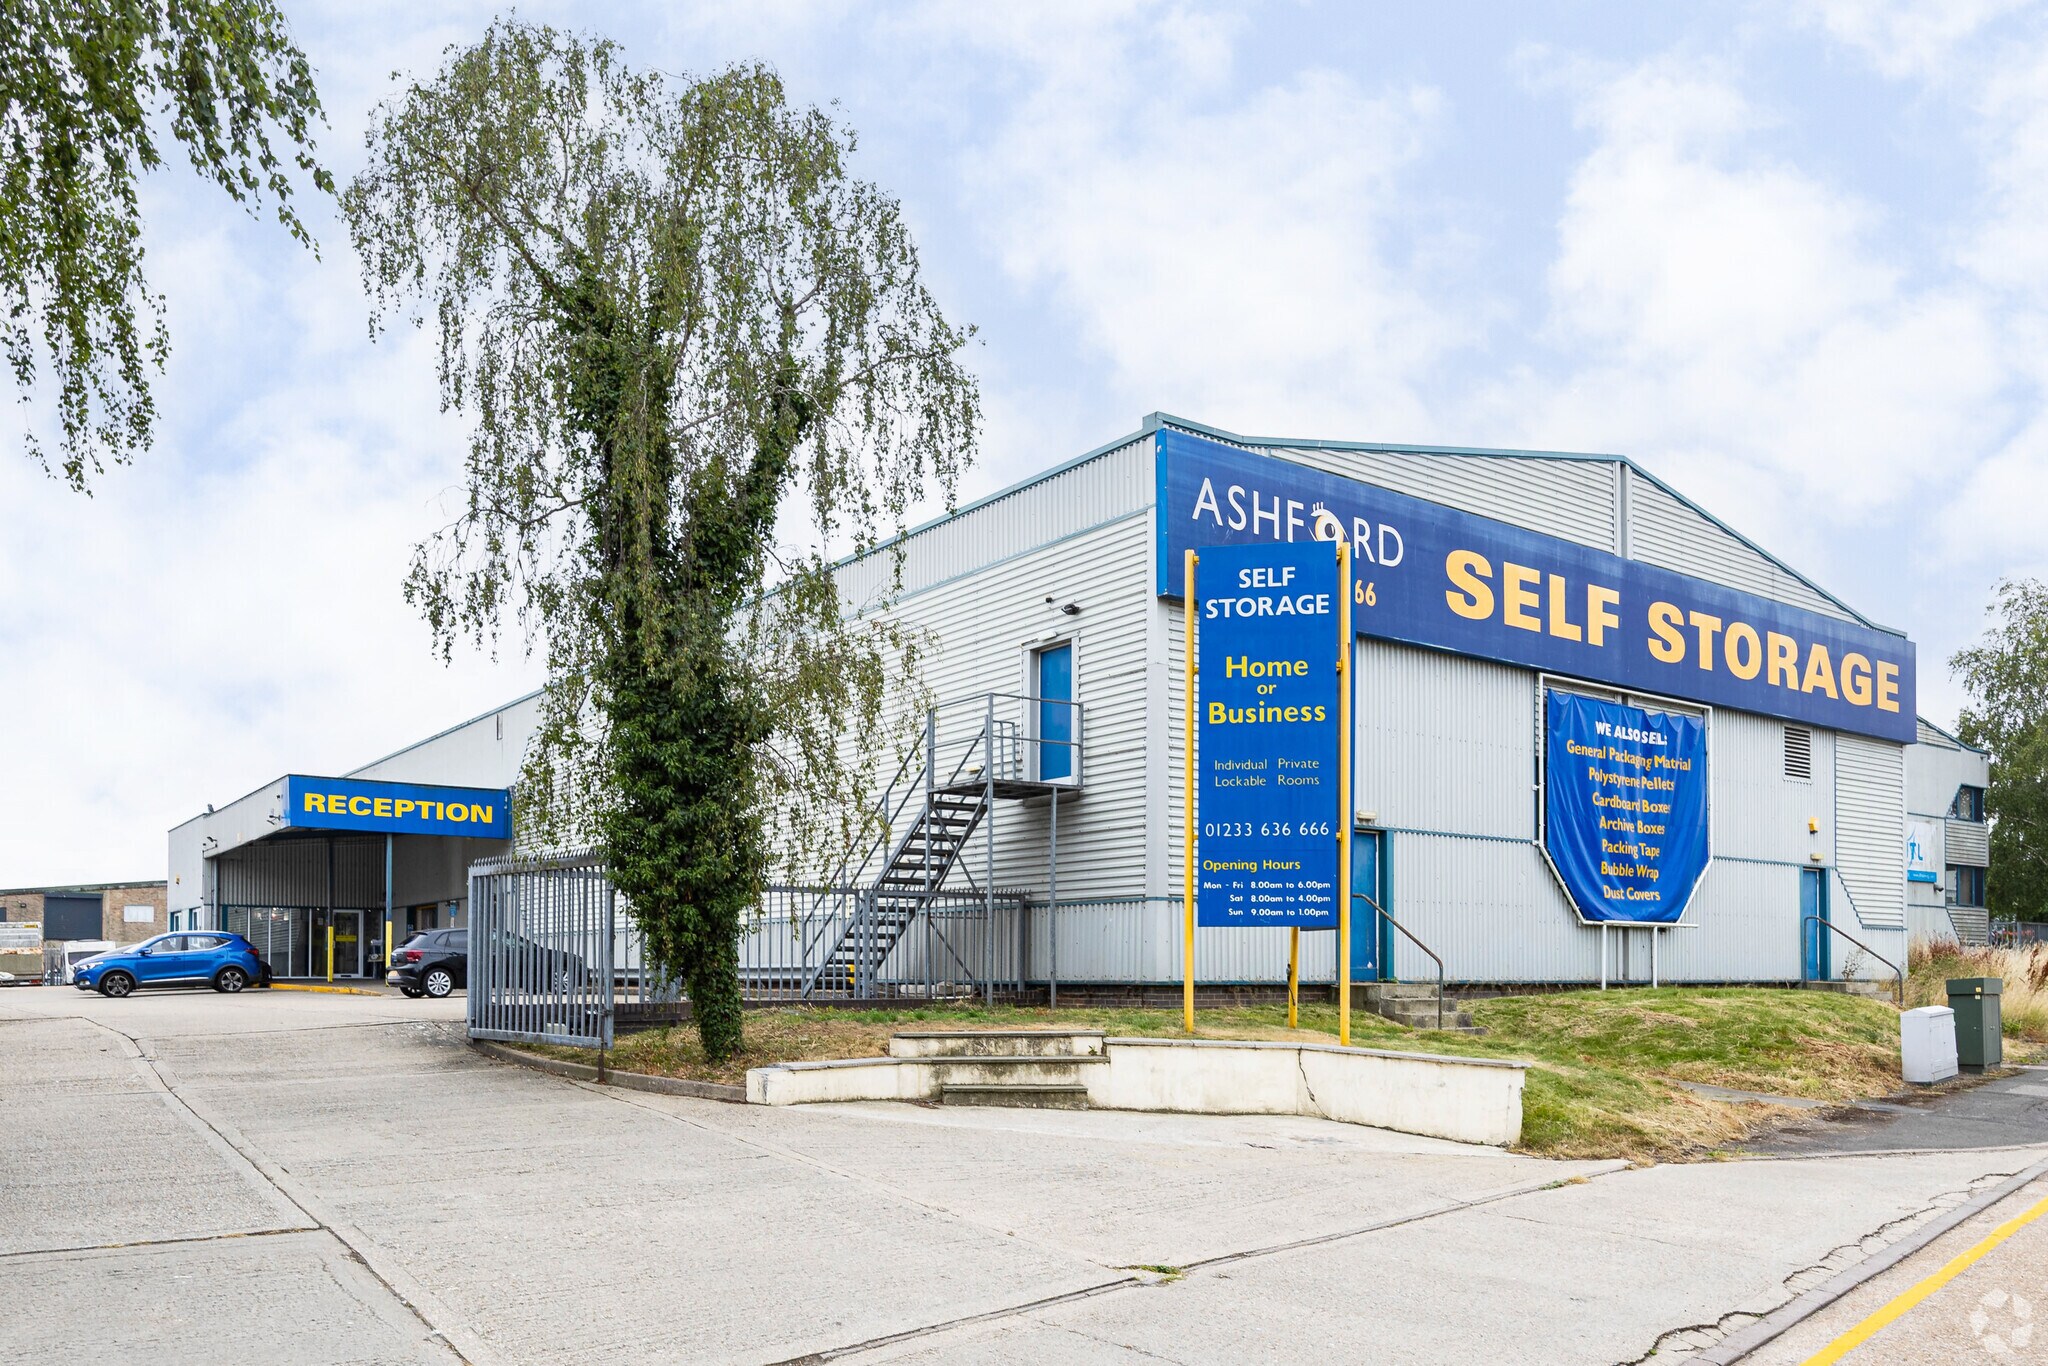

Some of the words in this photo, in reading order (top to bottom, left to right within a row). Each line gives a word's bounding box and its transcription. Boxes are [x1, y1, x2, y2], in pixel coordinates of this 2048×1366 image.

[1192, 477, 1404, 567] ASHFORD
[1238, 567, 1296, 588] SELF
[1205, 594, 1330, 619] STORAGE
[1445, 549, 1620, 647] SELF
[1647, 601, 1900, 714] STORAGE
[1225, 655, 1309, 679] Home
[1256, 683, 1277, 695] or
[1208, 701, 1326, 725] Business
[1595, 721, 1612, 737] WE
[1613, 725, 1640, 742] ALSO
[1566, 739, 1606, 759] General
[1214, 758, 1268, 771] Individual
[1277, 757, 1320, 769] Private
[1215, 775, 1267, 787] Lockable
[1277, 774, 1320, 786] Rooms
[1641, 776, 1675, 791] Pellets
[303, 792, 493, 824] RECEPTION
[1592, 791, 1641, 812] Cardboard
[1205, 822, 1252, 837] 01233
[1261, 822, 1291, 837] 636
[1299, 822, 1329, 836] 666
[1599, 815, 1635, 833] Archive
[1637, 820, 1666, 835] Boxes
[1602, 838, 1639, 860] Packing
[1638, 842, 1660, 860] Tape
[1203, 859, 1258, 873] Opening
[1263, 859, 1301, 870] Hours
[1601, 861, 1635, 877] Bubble
[1636, 863, 1660, 883] Wrap
[1203, 881, 1222, 889] Mon
[1232, 881, 1244, 889] Fri
[1250, 881, 1283, 889] 8.00am
[1286, 881, 1295, 889] to
[1297, 880, 1331, 890] 6.00pm
[1603, 884, 1625, 900] Dust
[1626, 886, 1661, 901] Covers
[1229, 894, 1244, 902] Sat
[1250, 894, 1283, 903] 8.00am
[1298, 894, 1331, 904] 4.00pm
[1228, 907, 1244, 916] Sun
[1250, 908, 1284, 916] 9.00am
[1286, 908, 1296, 916] to
[1298, 907, 1329, 917] 1.00pm
